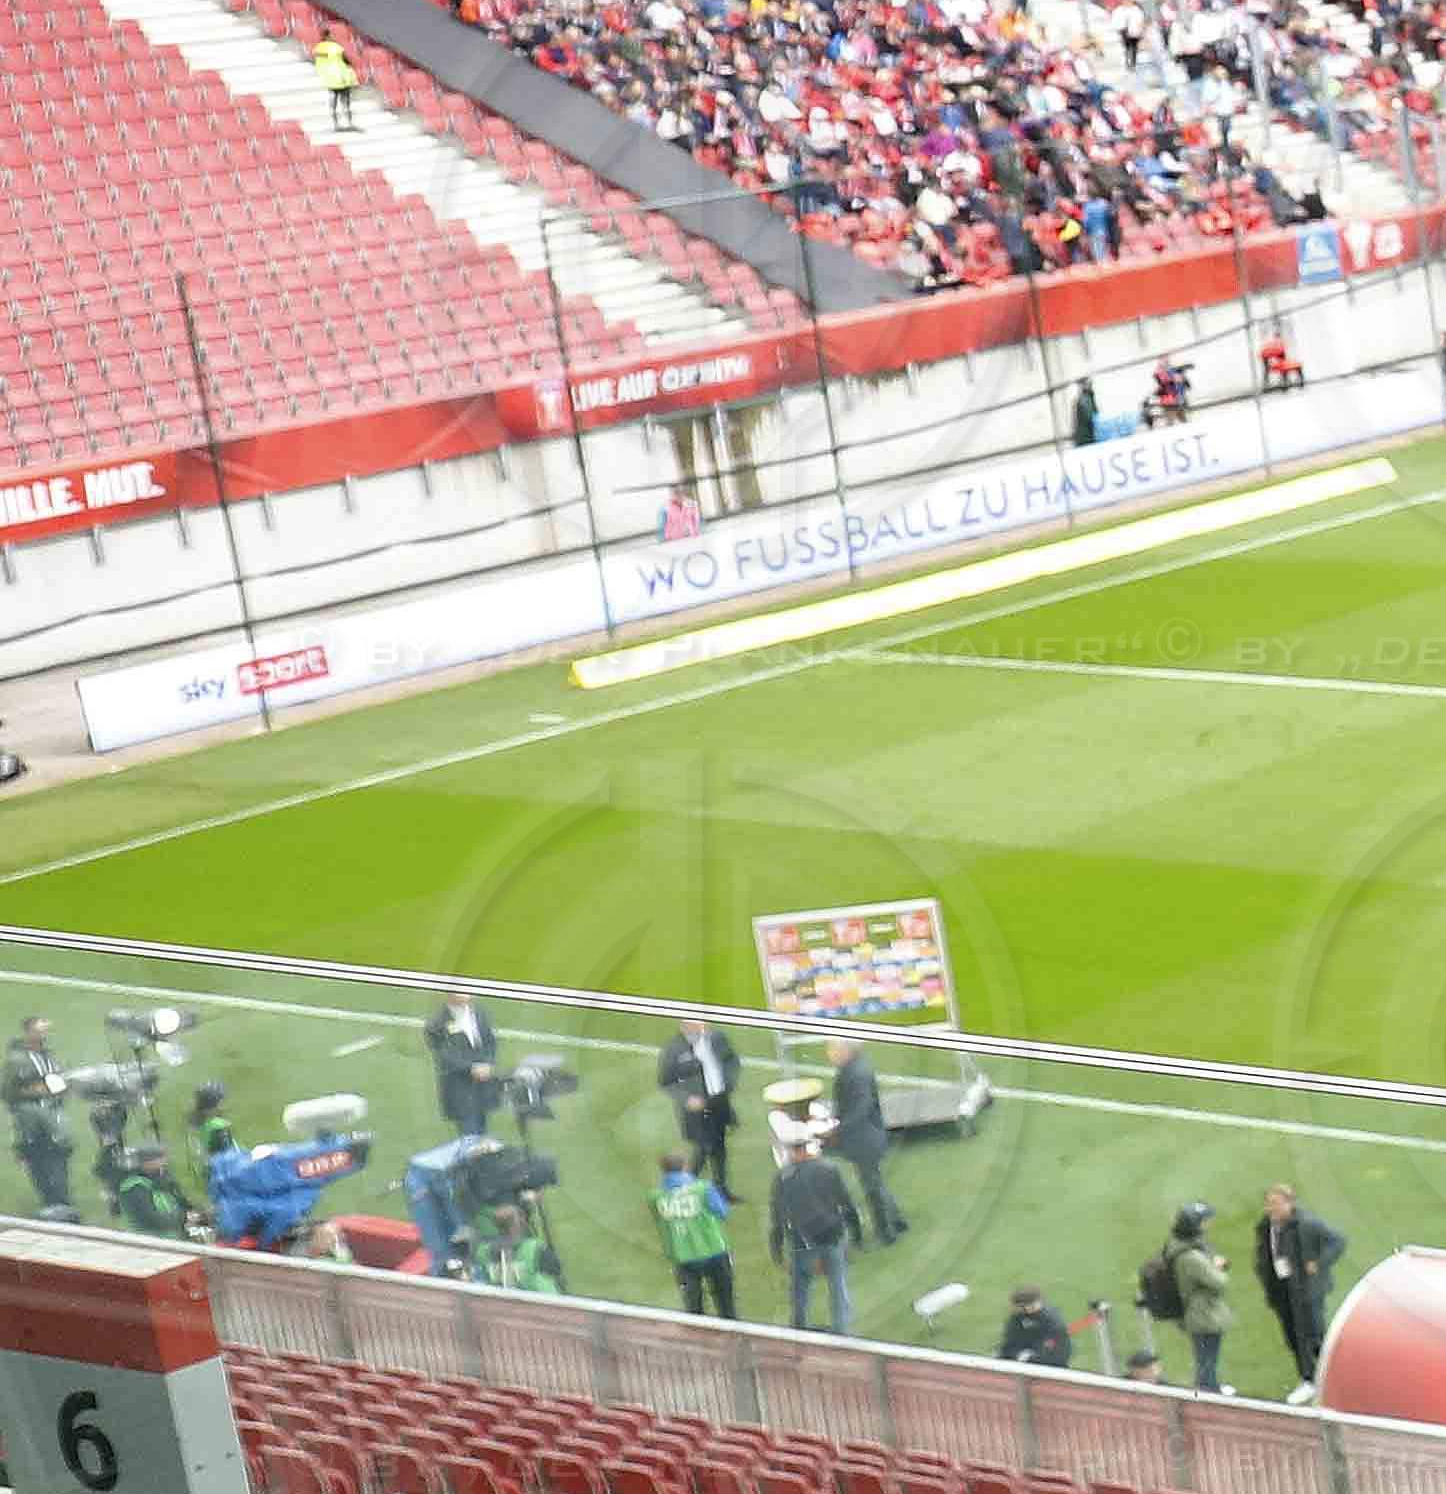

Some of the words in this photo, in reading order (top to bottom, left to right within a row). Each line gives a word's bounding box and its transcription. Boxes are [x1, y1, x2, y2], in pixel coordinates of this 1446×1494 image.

[0, 477, 85, 525] ILLE.
[82, 461, 166, 507] MUT.
[638, 548, 719, 597] WO
[733, 507, 947, 579] FUSSBALL
[958, 486, 1010, 525] ZU
[1023, 450, 1151, 509] HAUSE
[178, 676, 226, 705] sky
[57, 1390, 119, 1492] 6
